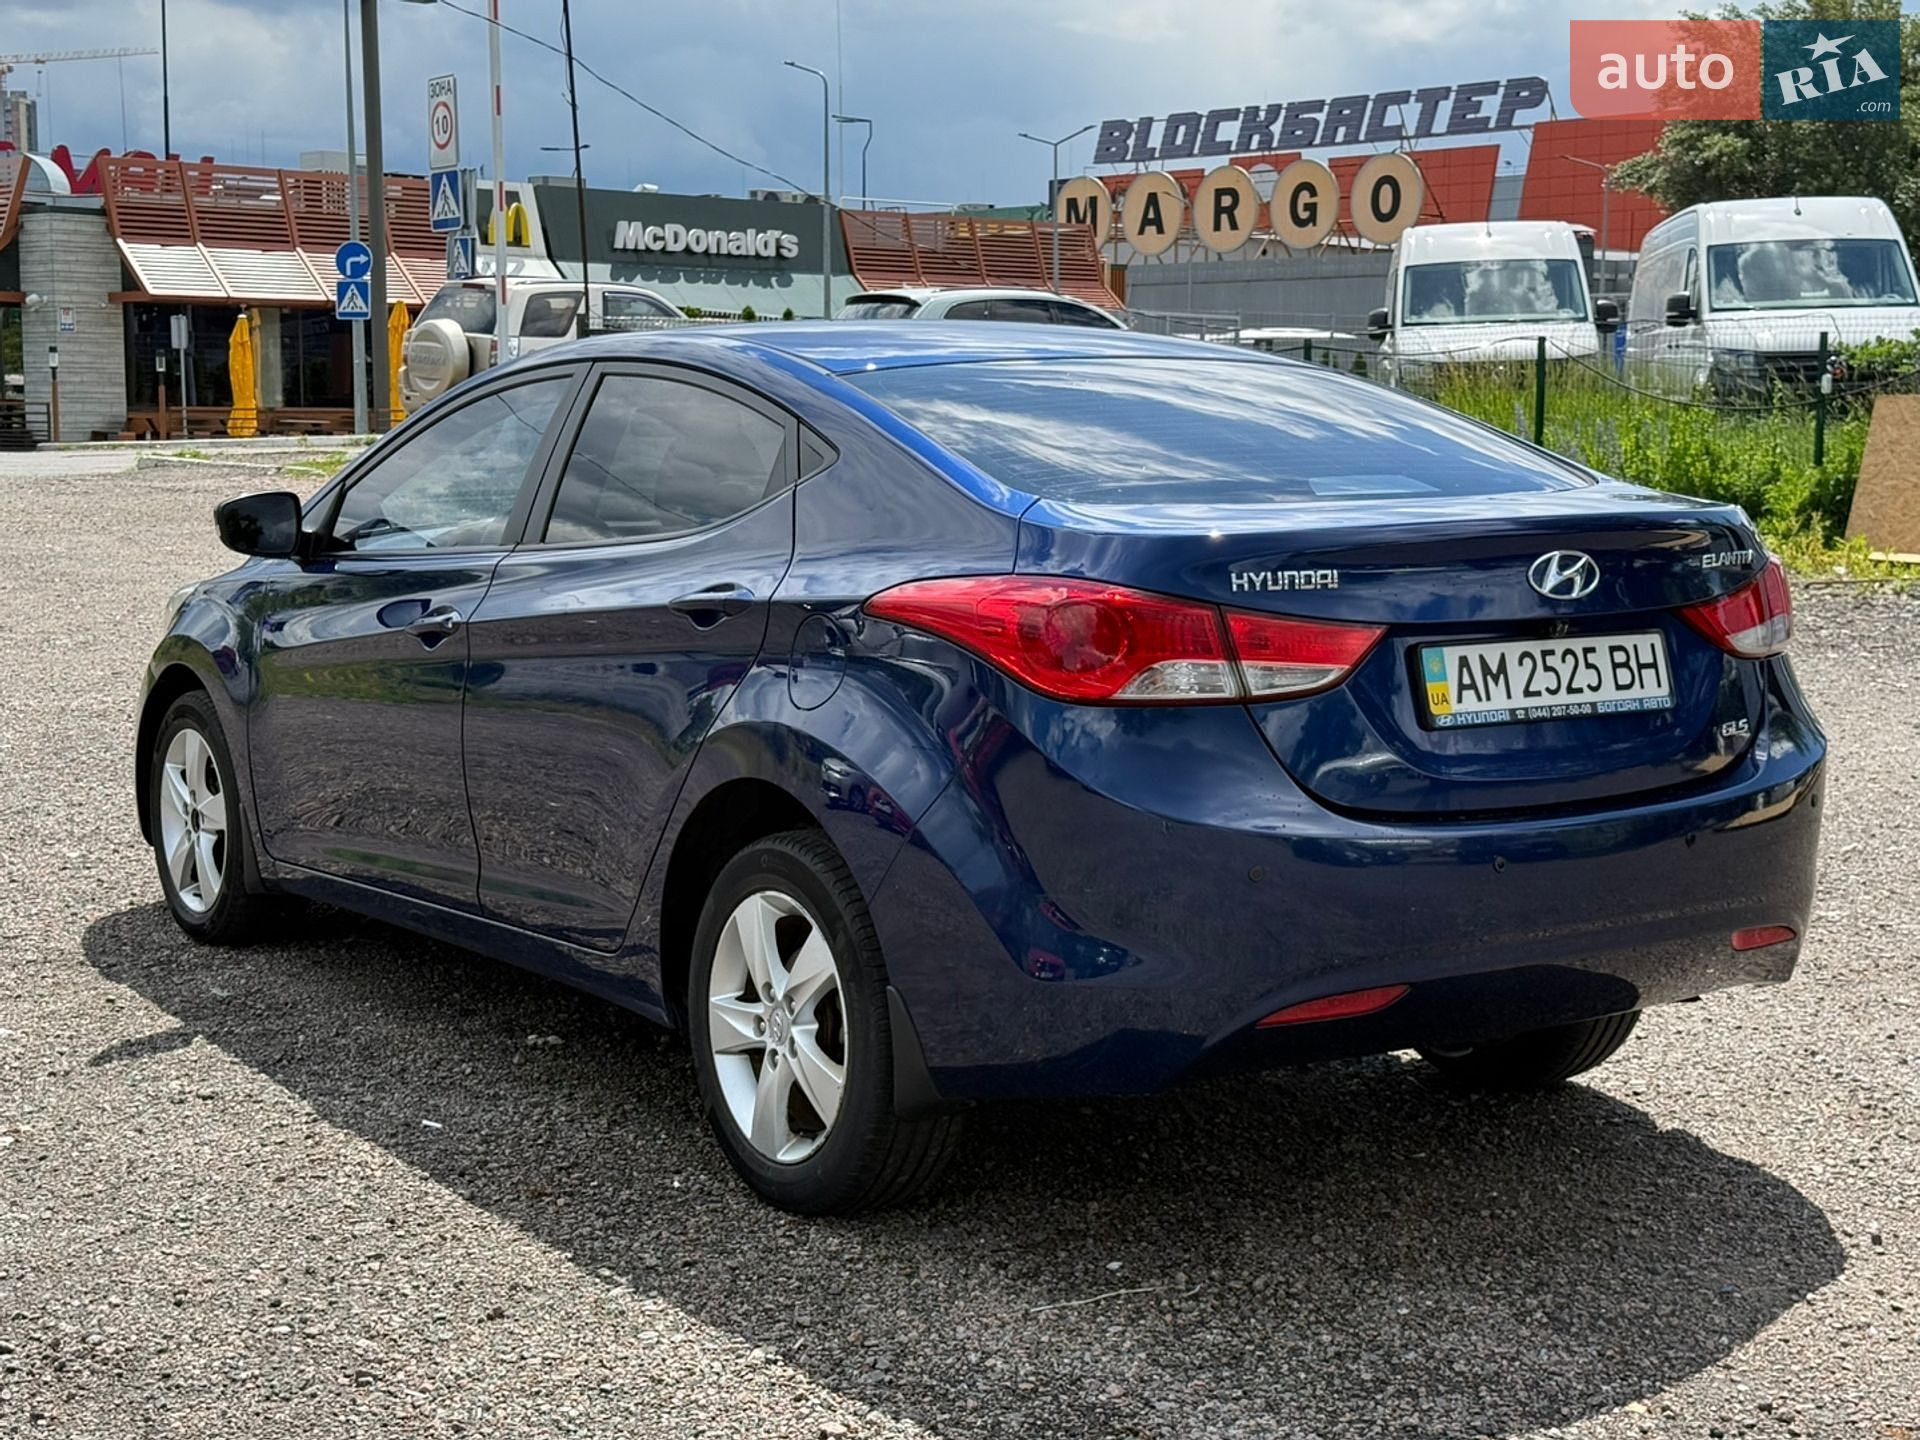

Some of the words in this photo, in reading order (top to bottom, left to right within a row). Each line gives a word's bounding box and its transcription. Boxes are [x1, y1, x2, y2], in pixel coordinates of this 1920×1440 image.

[430, 79, 453, 98] ЗОНА
[435, 114, 449, 136] 10
[1065, 174, 1403, 238] MARGO
[613, 220, 800, 258] McDonald's
[1230, 569, 1339, 592] HYUNDAI
[1456, 651, 1512, 704] AM
[1517, 646, 1601, 699] 2525
[1608, 642, 1662, 692] BH
[1430, 692, 1450, 706] UA
[1456, 710, 1511, 725] HYUNDAI
[1528, 706, 1550, 719] (044)
[1597, 700, 1640, 713] БОГДАН
[1643, 697, 1671, 709] АВТО
[1722, 718, 1749, 736] GLS
